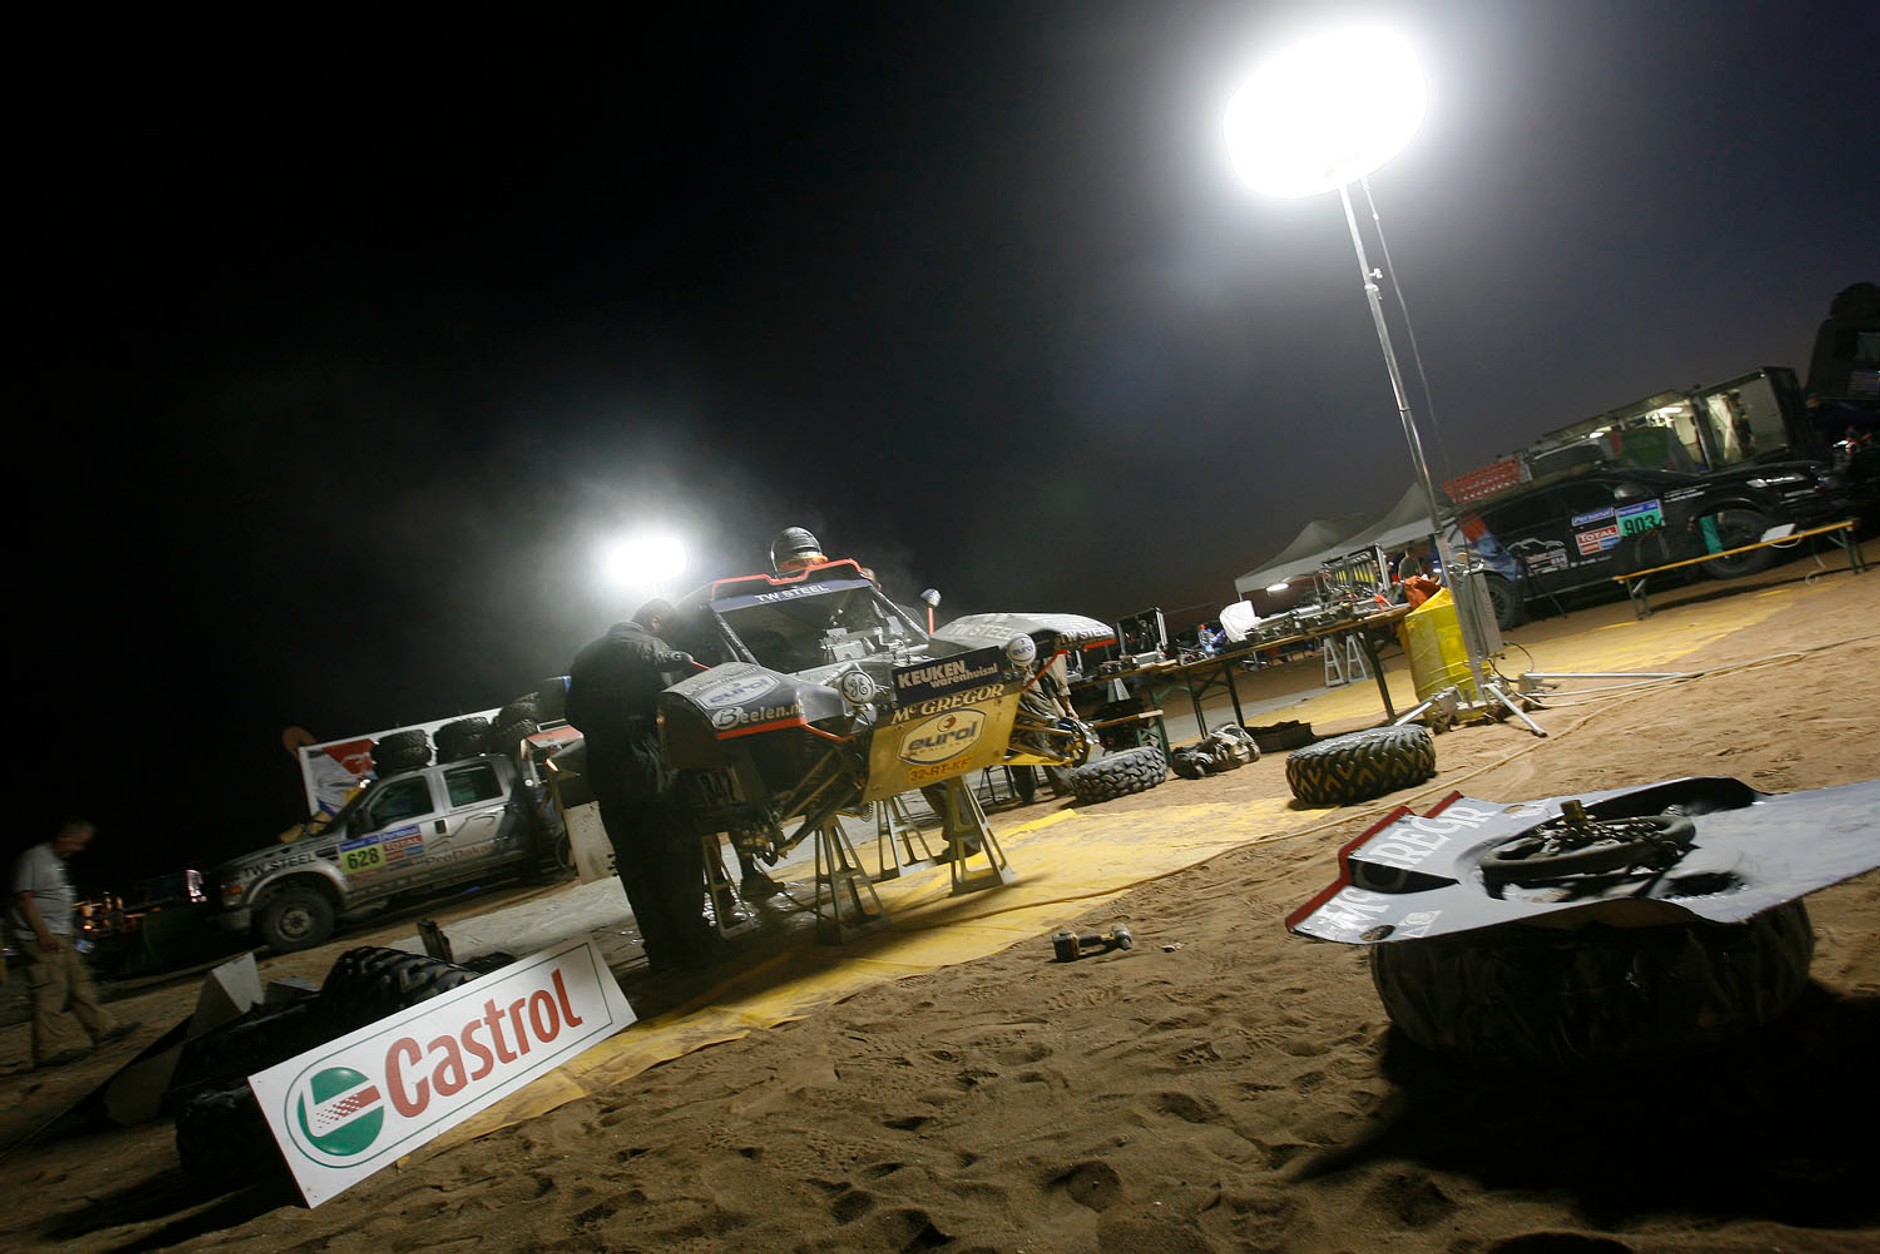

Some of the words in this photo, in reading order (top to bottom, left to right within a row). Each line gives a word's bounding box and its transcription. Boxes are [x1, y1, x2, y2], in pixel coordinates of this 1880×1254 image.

[1578, 527, 1616, 543] TOTAL
[754, 591, 779, 602] TW
[780, 584, 831, 600] STEEL
[897, 660, 966, 689] KEUKEN
[909, 721, 978, 751] eurol
[269, 852, 316, 872] STEEL
[347, 848, 379, 870] 628
[384, 967, 583, 1119] Castrol
